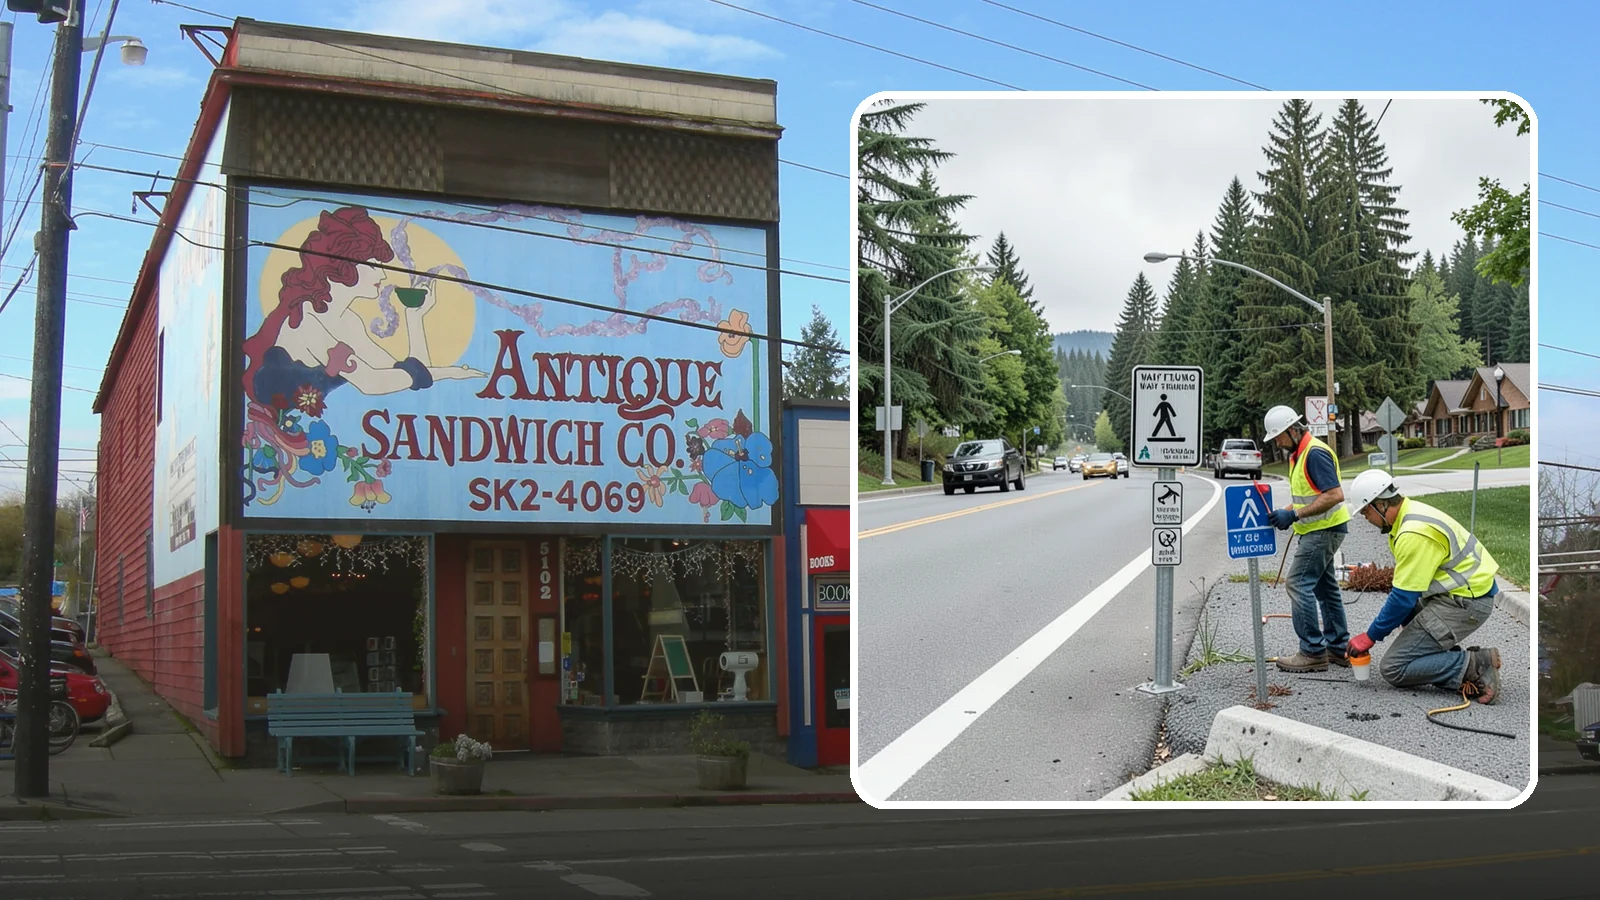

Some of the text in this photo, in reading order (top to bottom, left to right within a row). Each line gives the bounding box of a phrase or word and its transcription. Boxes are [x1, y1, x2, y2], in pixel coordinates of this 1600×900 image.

[475, 329, 724, 421] ANTIQUE
[361, 408, 685, 468] SANDWICH CO.
[468, 477, 646, 513] SK2-4069
[539, 541, 552, 600] 5102
[809, 555, 835, 569] BOOKS
